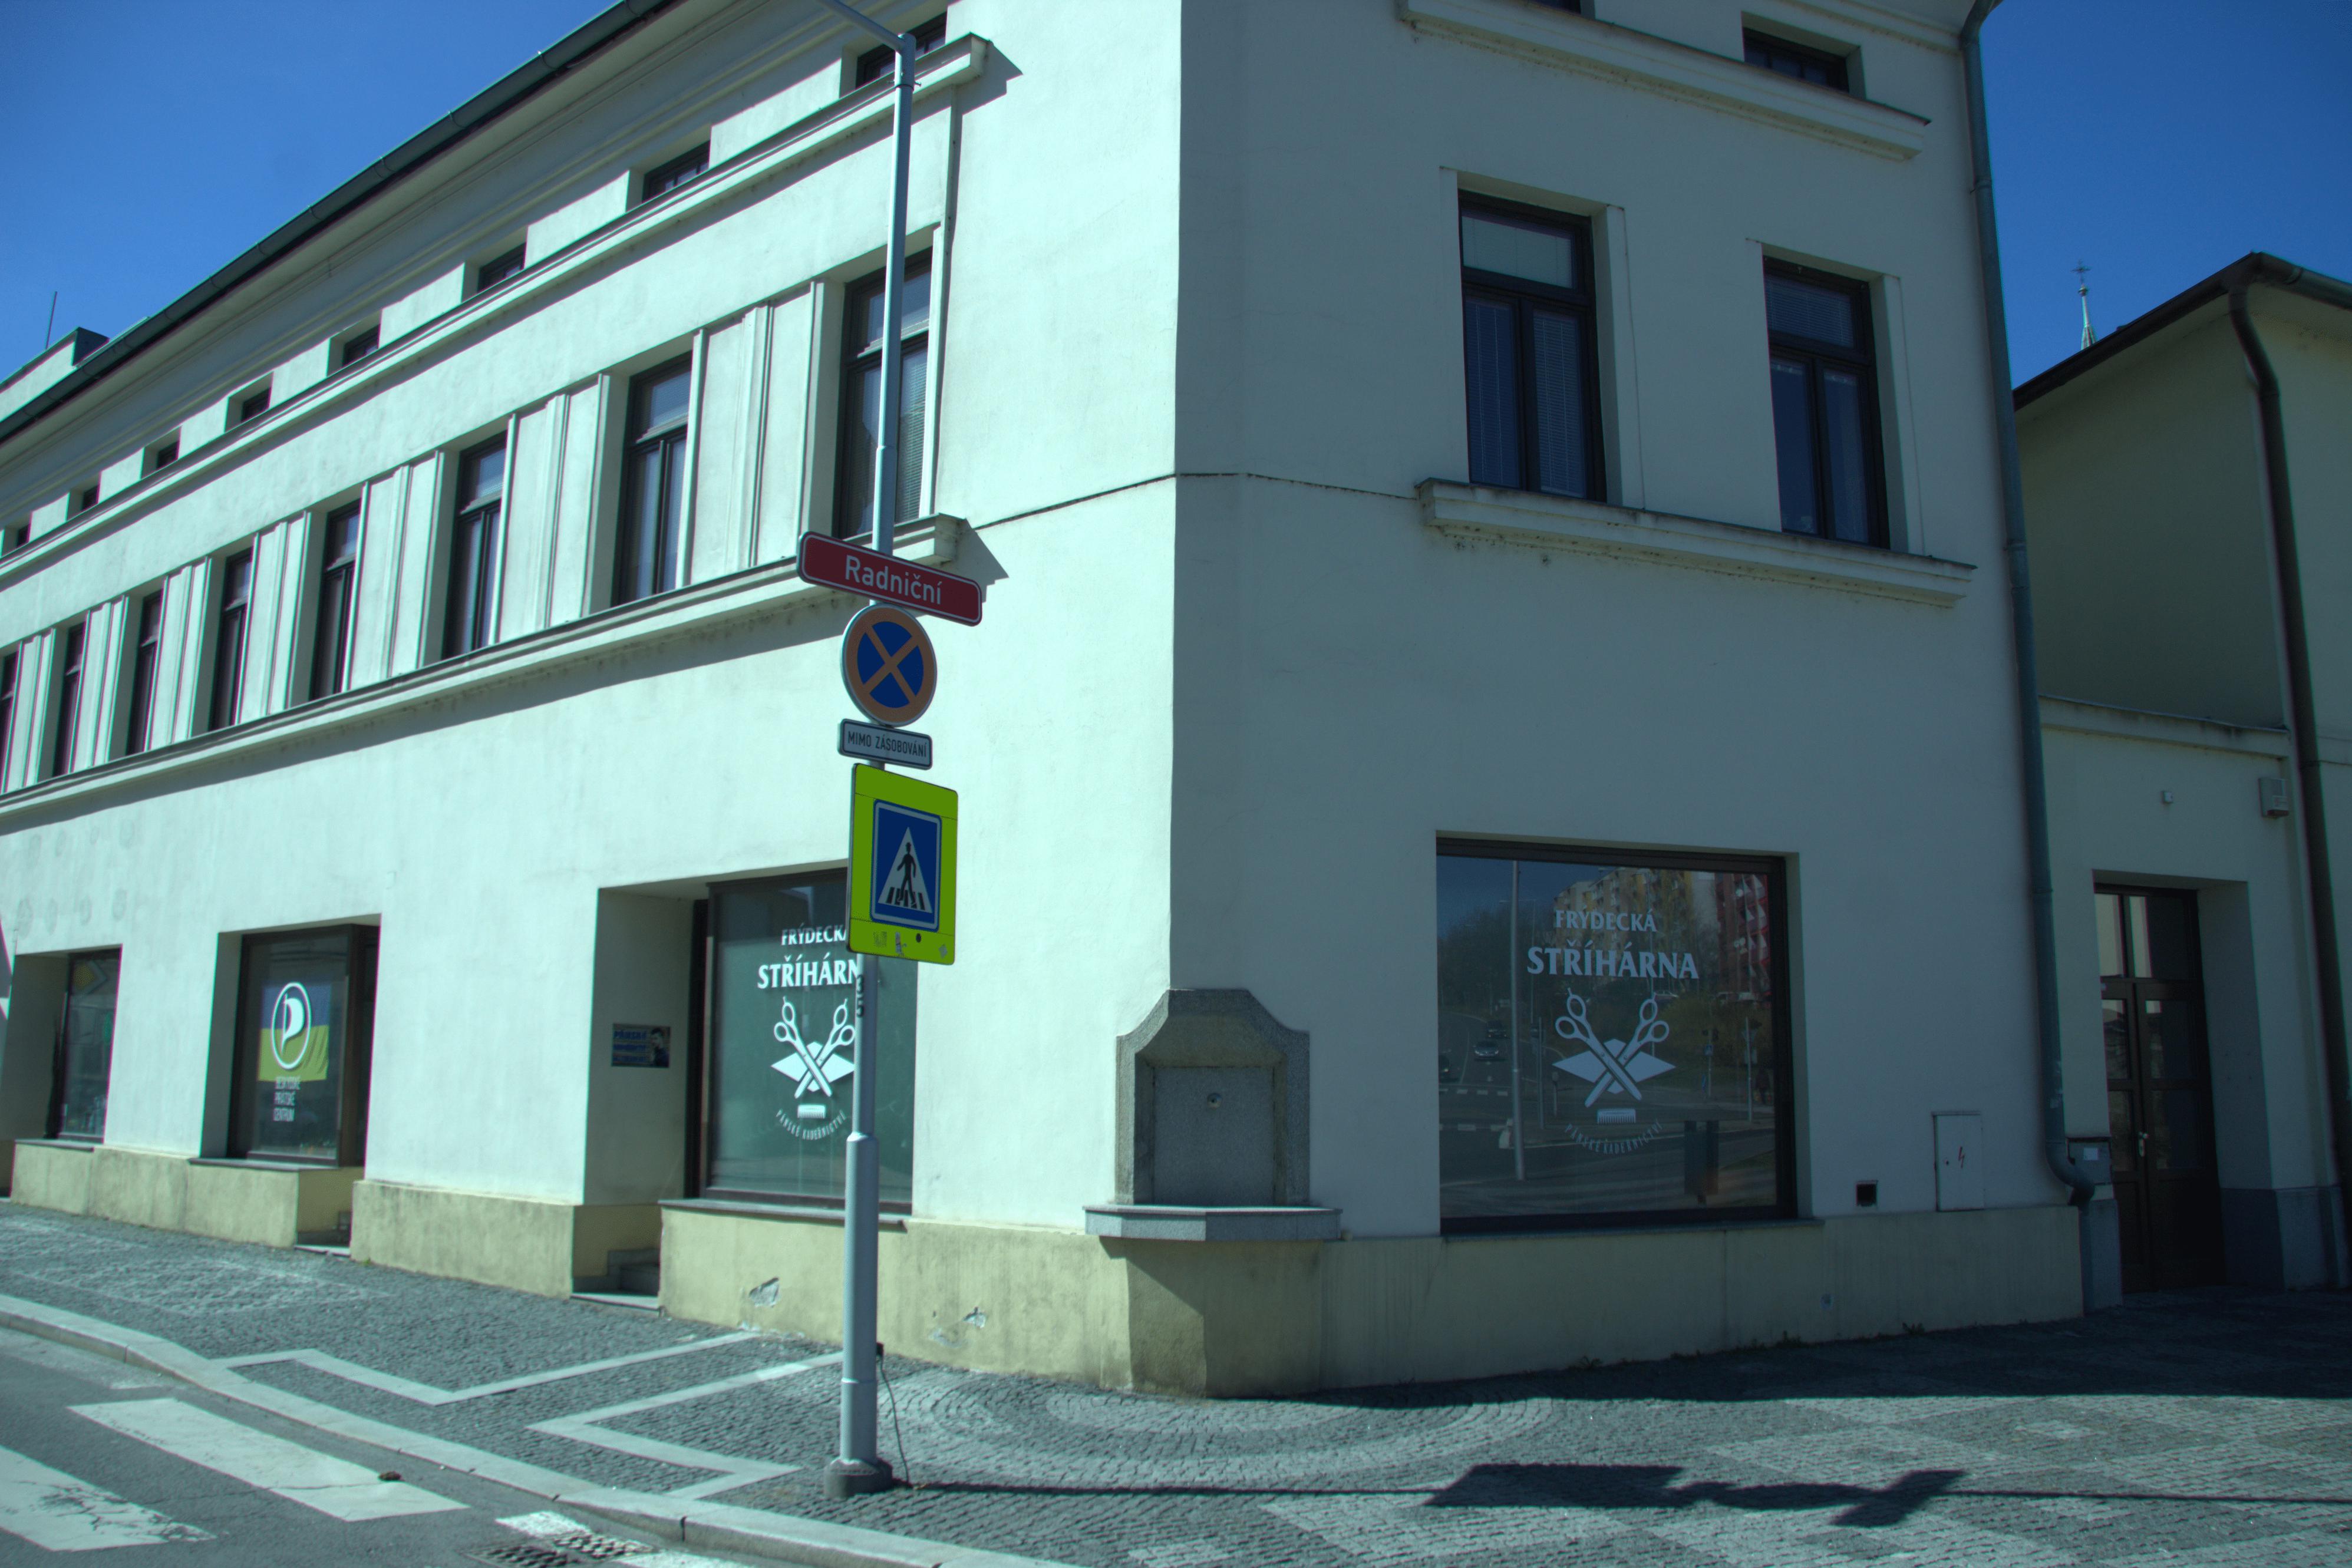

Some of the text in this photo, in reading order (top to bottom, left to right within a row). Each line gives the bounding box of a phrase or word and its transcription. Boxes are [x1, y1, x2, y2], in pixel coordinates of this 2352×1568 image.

[845, 555, 942, 605] Radniční
[847, 731, 927, 758] MIMO ZÁSOBOVÁNÍ
[1555, 905, 1657, 932] FRÝDECKÁ
[757, 952, 858, 989] STŘÍHÁRN
[1526, 939, 1699, 979] STŘÍHÁRNA
